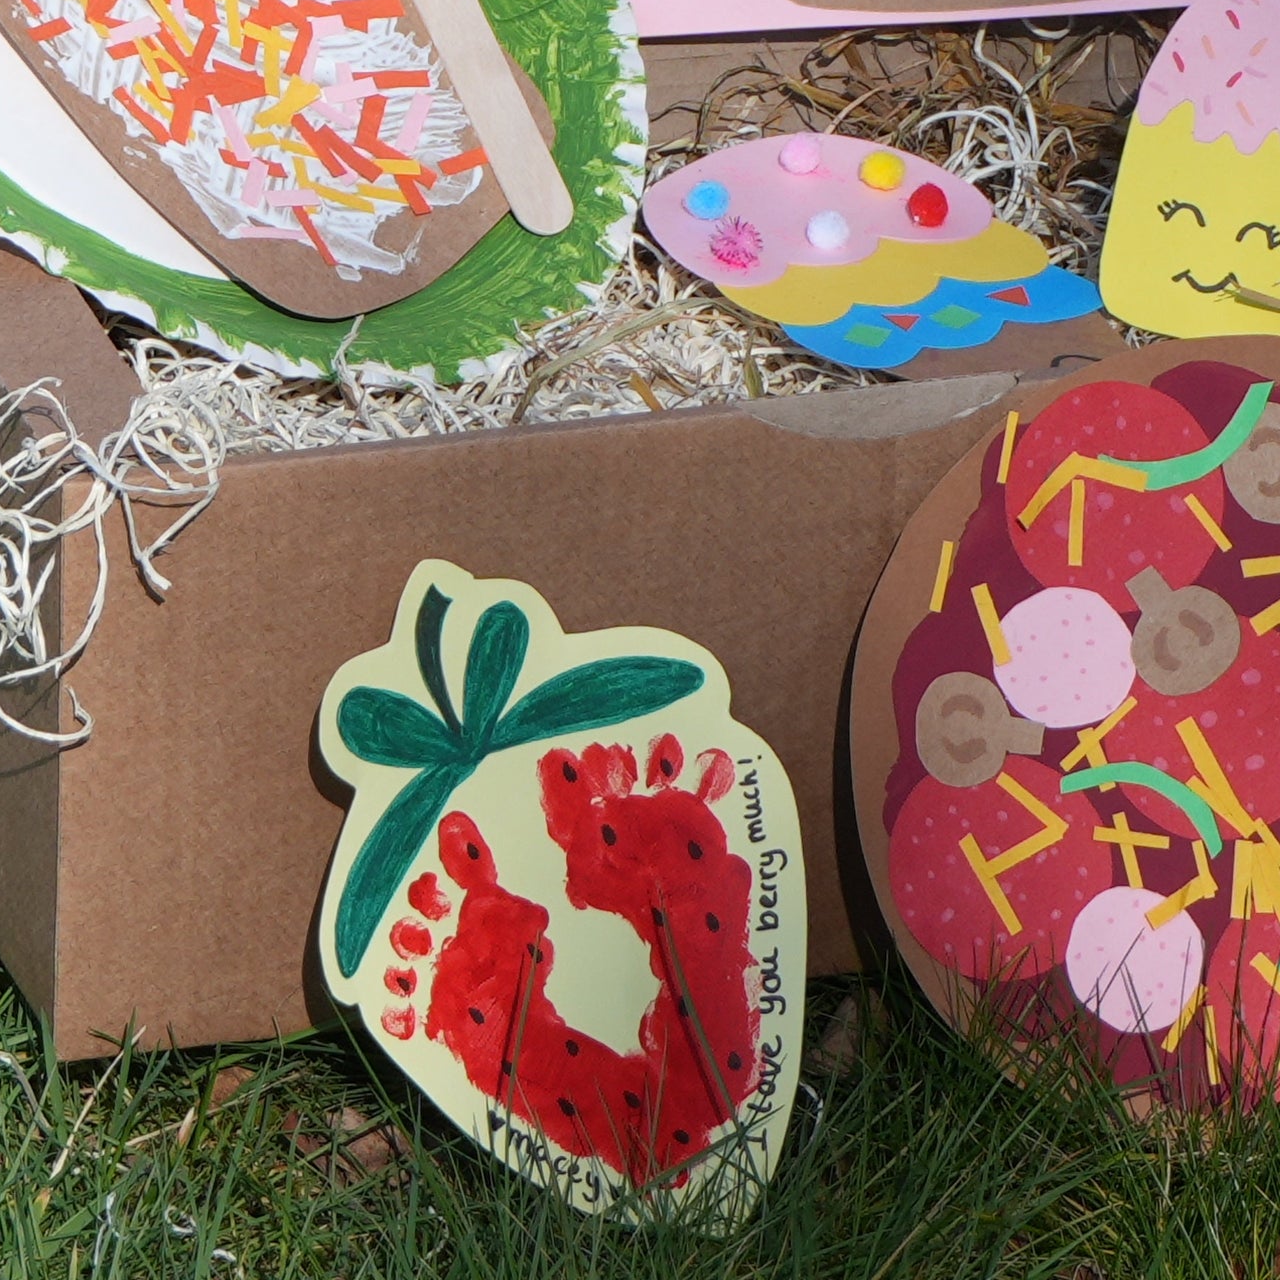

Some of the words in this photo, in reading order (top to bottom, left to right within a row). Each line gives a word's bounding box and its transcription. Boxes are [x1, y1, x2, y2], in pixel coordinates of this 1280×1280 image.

[737, 754, 766, 844] much!
[756, 849, 788, 932] berry
[759, 947, 786, 1015] you
